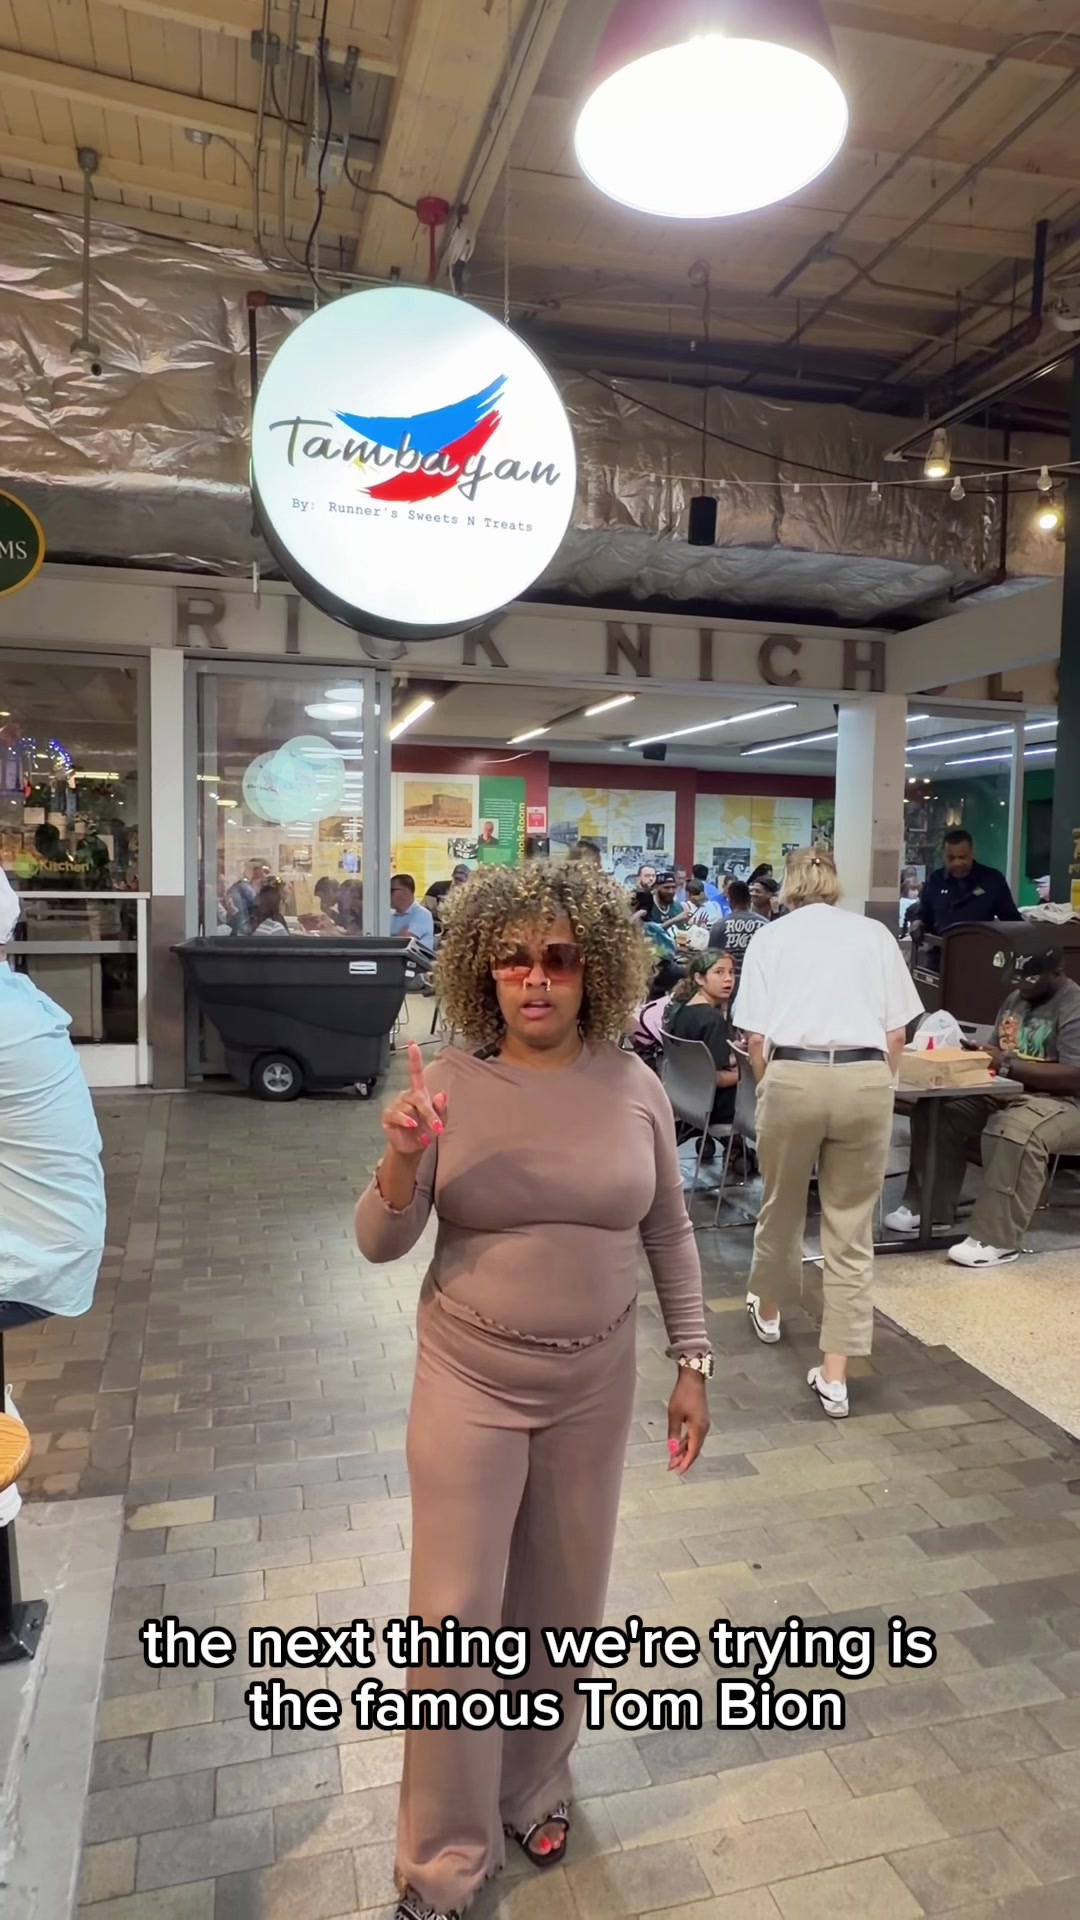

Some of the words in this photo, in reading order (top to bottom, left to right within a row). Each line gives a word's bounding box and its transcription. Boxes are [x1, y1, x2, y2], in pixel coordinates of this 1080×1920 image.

[269, 416, 560, 501] Tambayan
[291, 498, 316, 512] By:
[328, 501, 398, 519] Runner's
[408, 509, 458, 525] Sweets
[467, 516, 475, 526] N
[484, 517, 533, 532] Treats
[516, 802, 525, 832] Room
